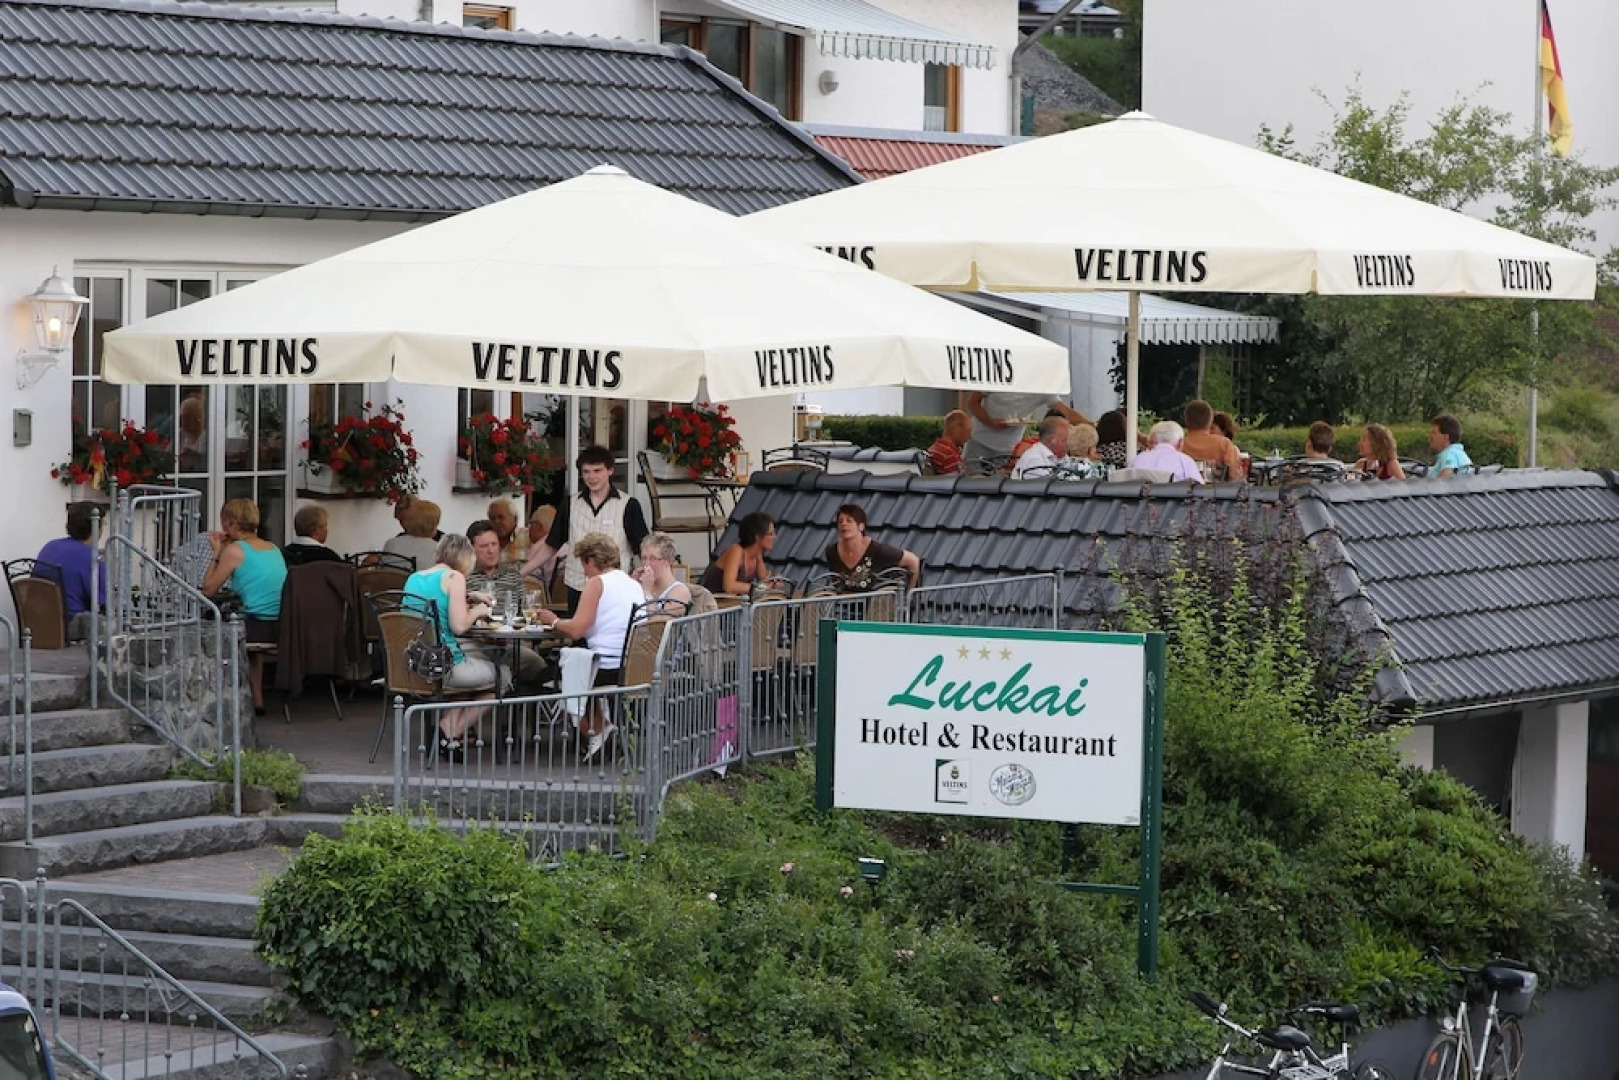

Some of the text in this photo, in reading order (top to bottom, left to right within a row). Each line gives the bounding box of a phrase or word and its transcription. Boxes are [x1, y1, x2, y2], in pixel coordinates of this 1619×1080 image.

[1074, 248, 1207, 283] VELTINS
[1353, 255, 1415, 287] VELTINS
[1498, 259, 1553, 291] VELTINS
[175, 338, 318, 376] VELTINS
[471, 343, 622, 389] VELTINS
[754, 345, 834, 387] VELTINS
[946, 345, 1014, 383] VELTINS
[888, 654, 1088, 716] Luckai
[860, 718, 1117, 757] Hotel & Restaurant
